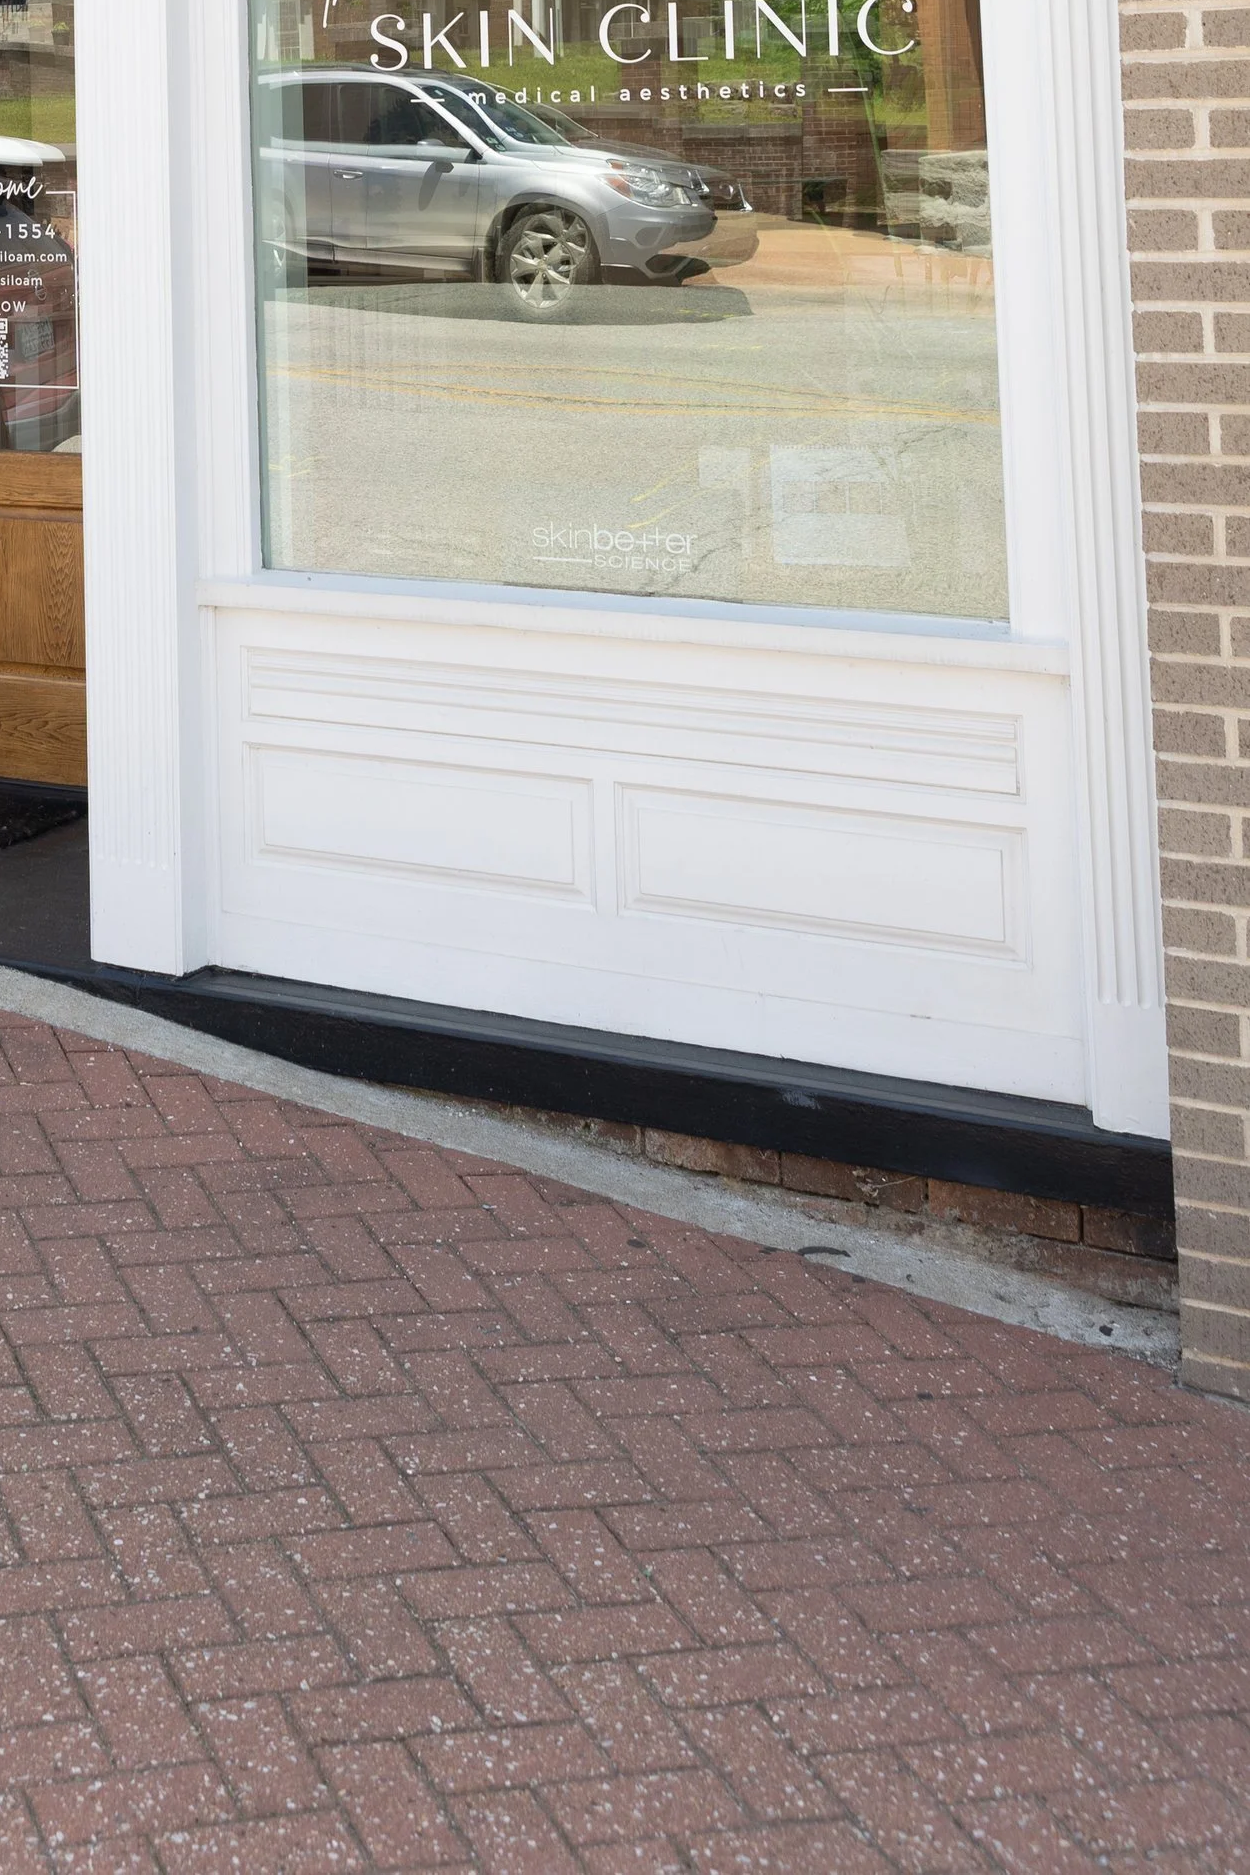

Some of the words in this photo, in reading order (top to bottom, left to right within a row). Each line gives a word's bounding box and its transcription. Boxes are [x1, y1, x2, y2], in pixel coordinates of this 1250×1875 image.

[369, 8, 559, 72] SKIN
[468, 84, 597, 107] medical
[618, 81, 809, 104] aesthetics
[594, 554, 692, 573] SCIENCE
